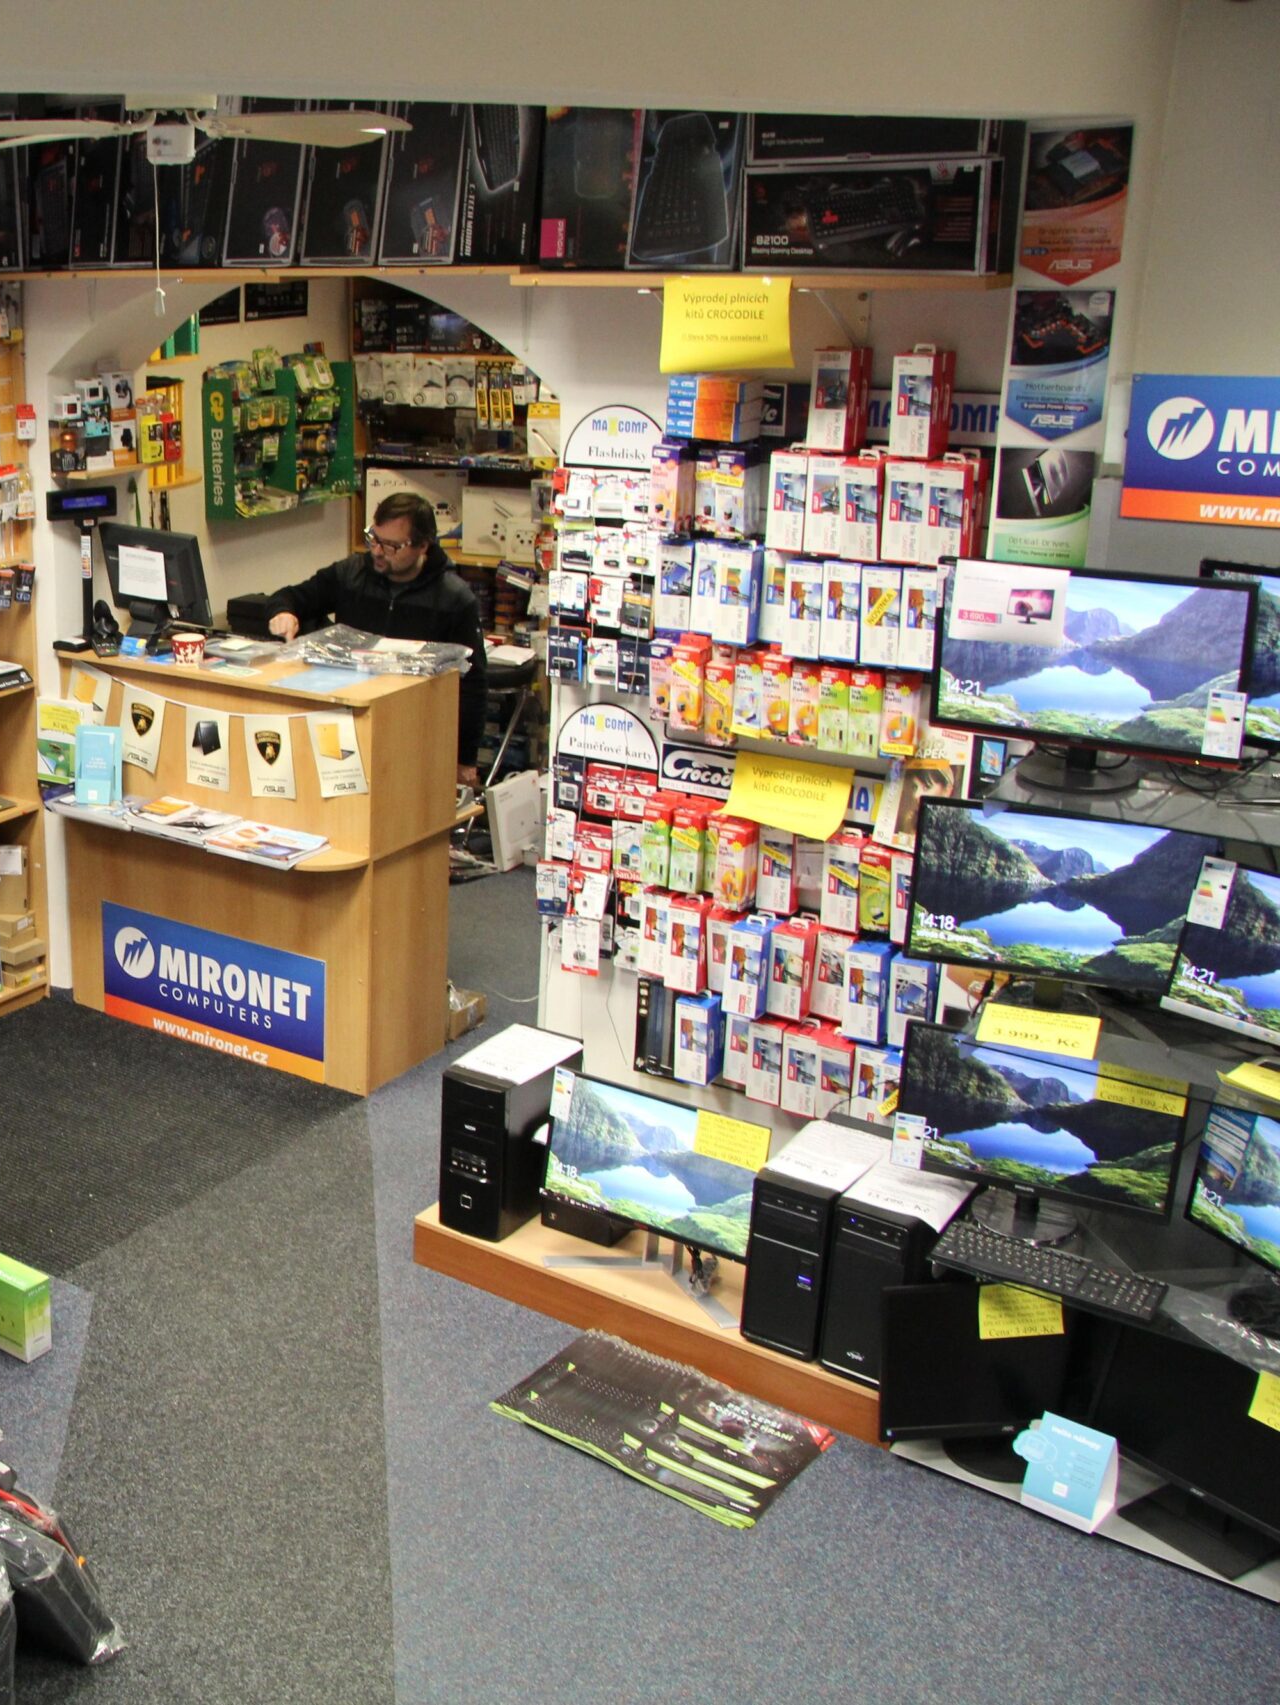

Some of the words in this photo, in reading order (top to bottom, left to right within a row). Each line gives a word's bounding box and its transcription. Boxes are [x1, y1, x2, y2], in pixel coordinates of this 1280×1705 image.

[1047, 259, 1093, 273] ASUS
[683, 293, 727, 305] Výprodej
[685, 308, 704, 320] kitů
[706, 309, 765, 320] CROCODILE
[209, 391, 225, 422] GP
[1030, 414, 1077, 427] ASUS
[588, 445, 647, 462] Flashdisky
[210, 428, 225, 507] Batteries
[944, 679, 981, 696] 14:21
[127, 752, 148, 764] ASUS
[625, 747, 653, 762] karty
[198, 775, 220, 785] ASUS
[752, 766, 797, 784] Výprodej
[263, 784, 286, 793] ASUS
[333, 782, 357, 791] ASUS
[773, 785, 826, 802] CROCODILE
[919, 912, 956, 931] 14:18
[158, 943, 312, 1021] MIRONET
[1182, 964, 1215, 985] 14:21
[159, 983, 273, 1029] COMPUTERS
[152, 1015, 269, 1065] www.mironet.cz
[727, 1402, 749, 1417] PRO
